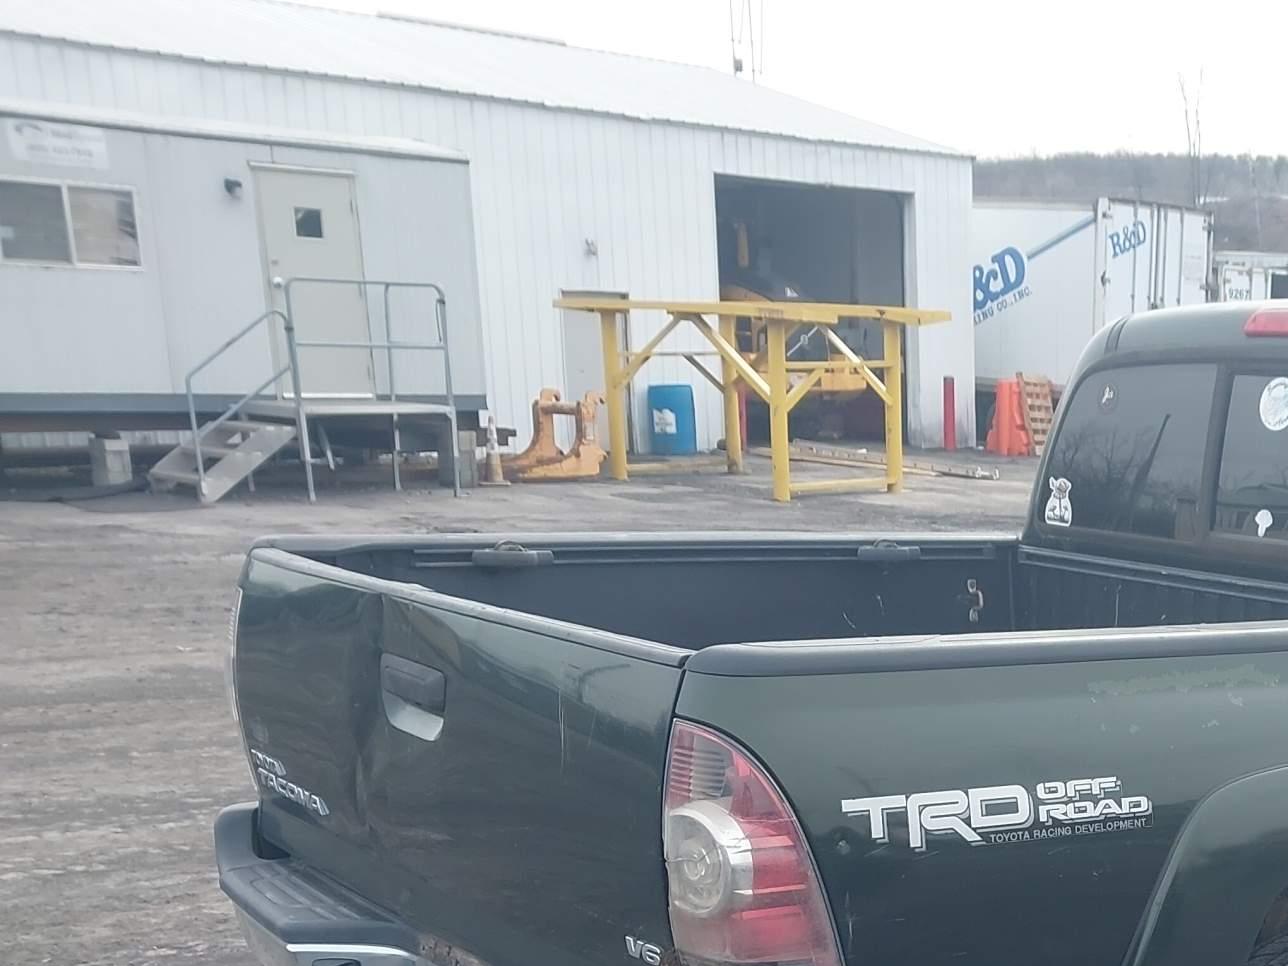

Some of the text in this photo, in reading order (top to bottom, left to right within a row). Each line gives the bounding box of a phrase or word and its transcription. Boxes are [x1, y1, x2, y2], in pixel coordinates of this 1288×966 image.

[1108, 220, 1147, 258] R&D
[973, 246, 1025, 312] &D
[257, 767, 330, 816] TACOMA
[1036, 776, 1121, 801] OFF
[841, 784, 1034, 852] TRD
[1037, 796, 1152, 824] ROAD
[990, 816, 1147, 845] TOYOTA RACING DEVELOPMENT
[625, 935, 661, 966] V6
